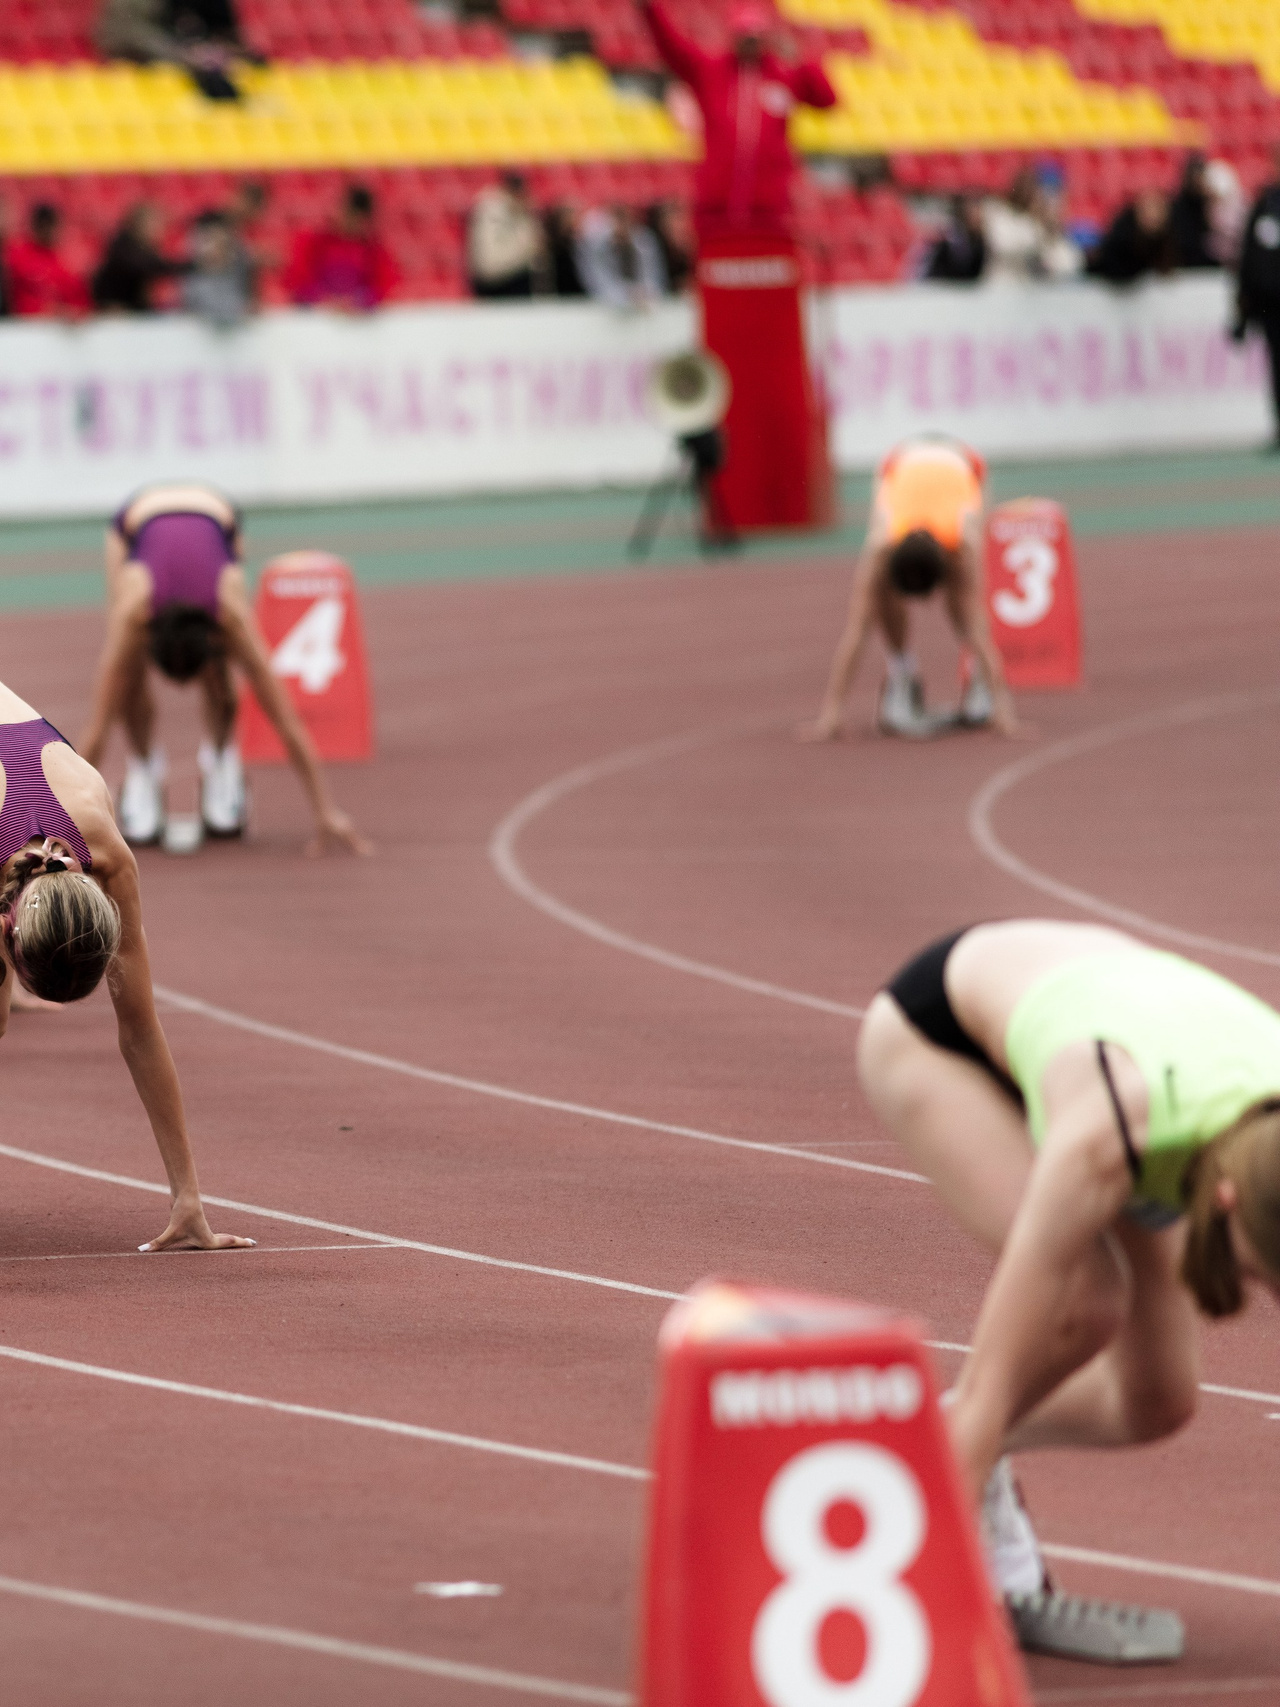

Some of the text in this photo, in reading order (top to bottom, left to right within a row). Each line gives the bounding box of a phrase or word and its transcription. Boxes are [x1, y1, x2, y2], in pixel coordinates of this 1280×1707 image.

[994, 536, 1058, 628] 3
[270, 597, 347, 693] 4
[710, 1365, 923, 1431] MONDO
[752, 1440, 933, 1707] 8
